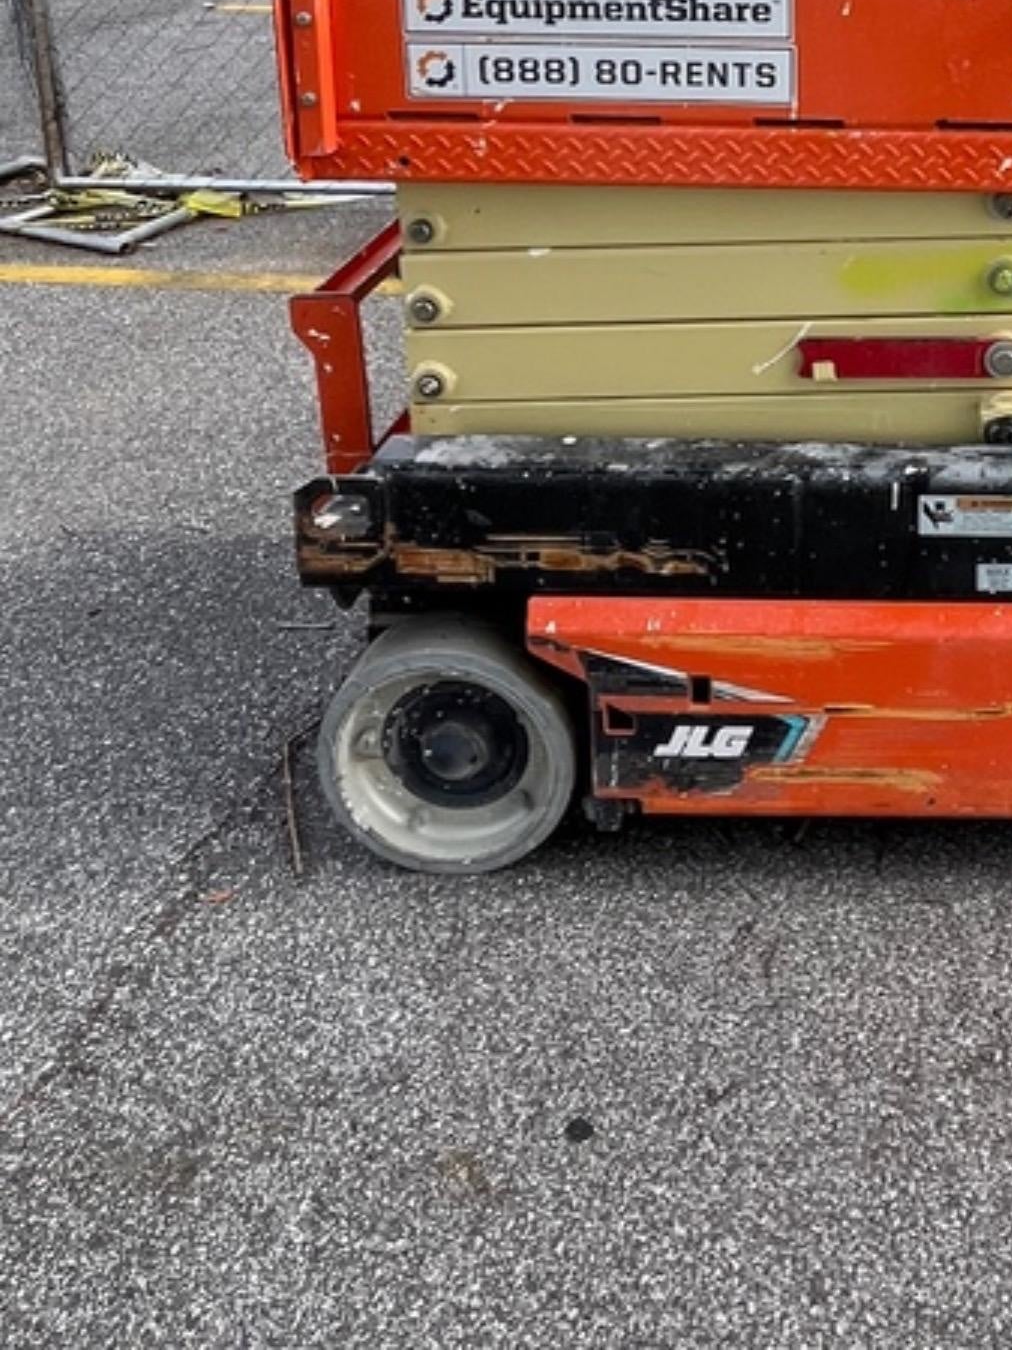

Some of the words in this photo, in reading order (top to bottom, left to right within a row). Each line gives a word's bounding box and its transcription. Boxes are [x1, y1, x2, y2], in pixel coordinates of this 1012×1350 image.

[478, 56, 580, 87] (888)
[595, 58, 776, 89] 80-RENTS
[653, 724, 754, 758] JLG
